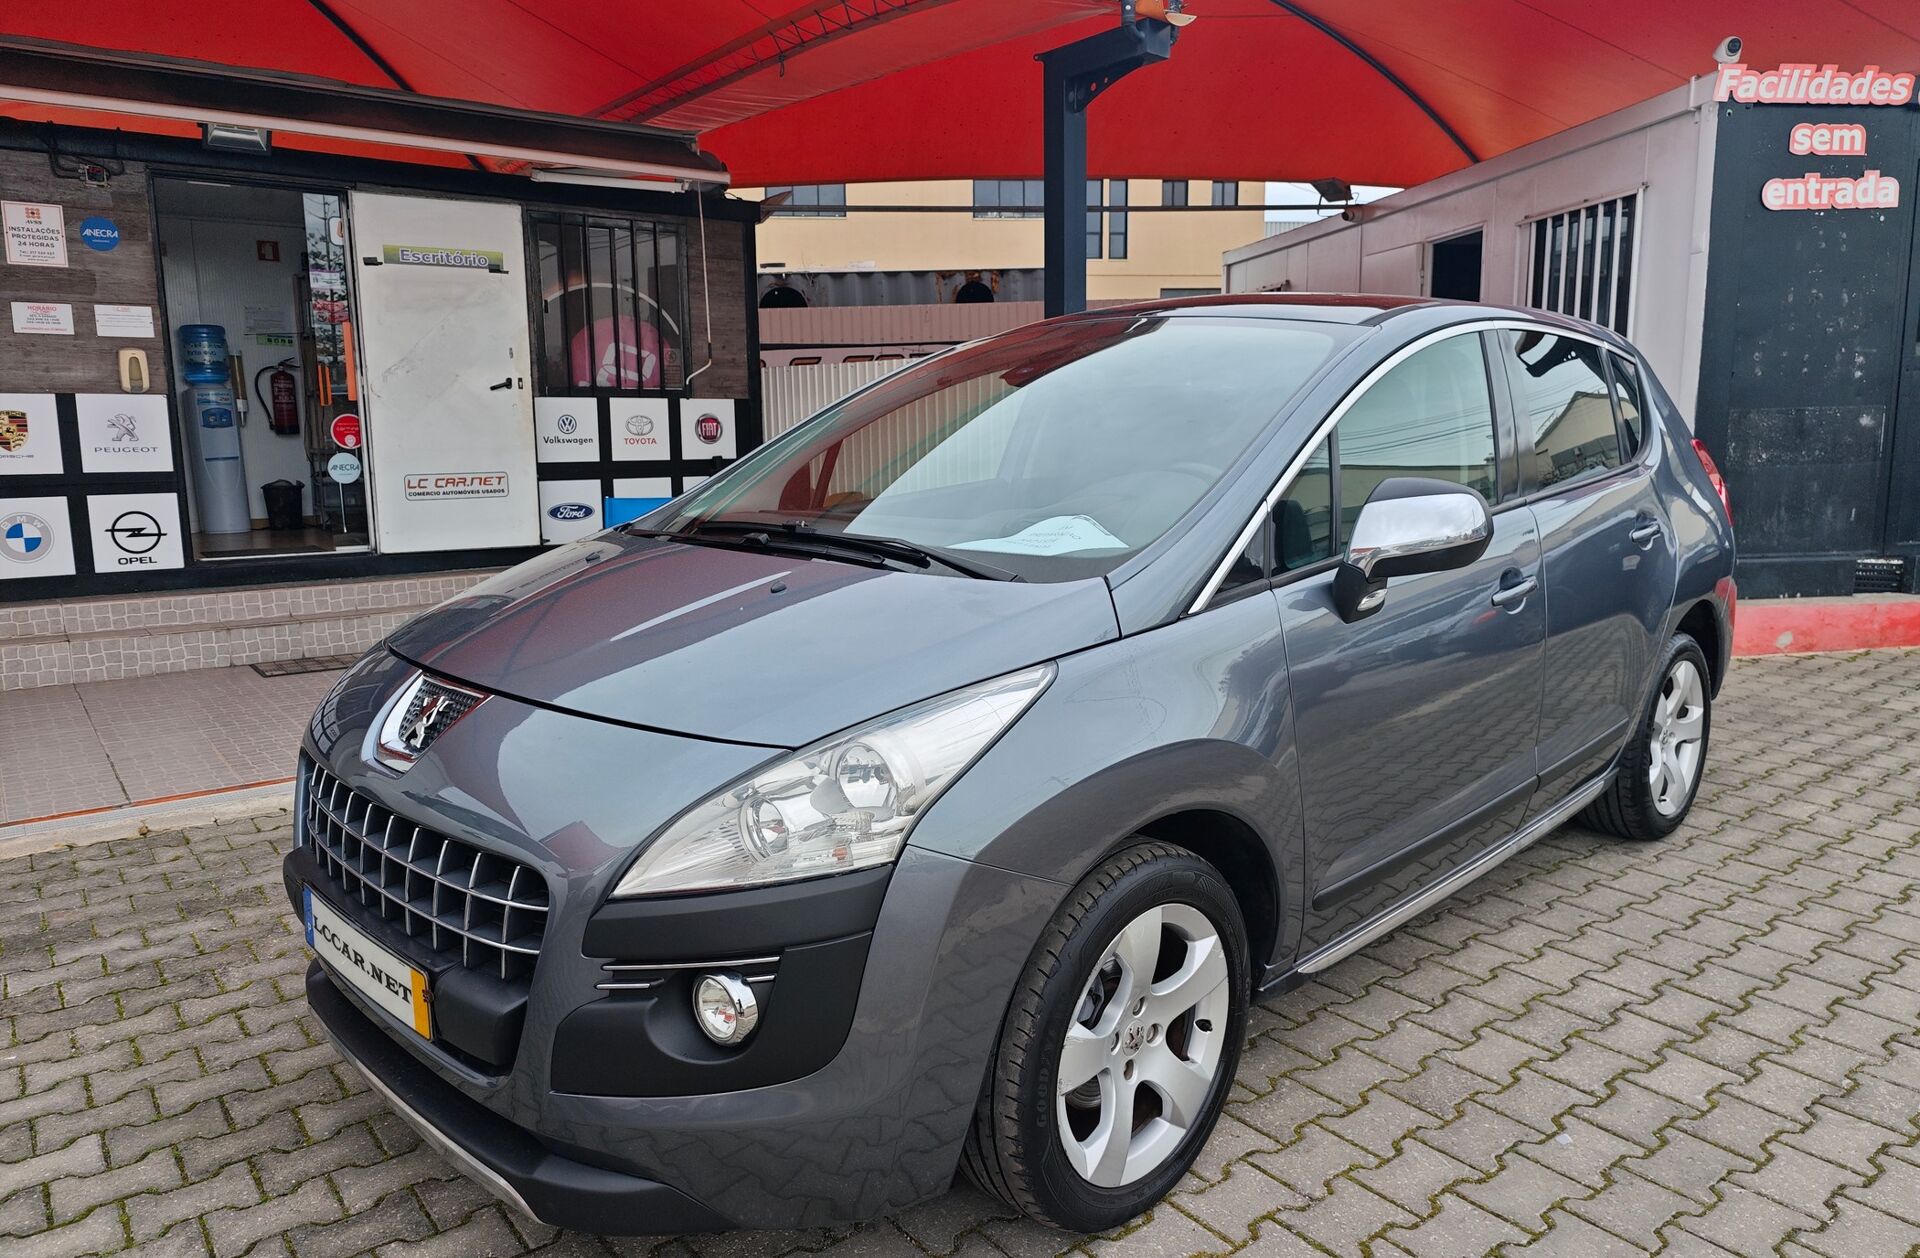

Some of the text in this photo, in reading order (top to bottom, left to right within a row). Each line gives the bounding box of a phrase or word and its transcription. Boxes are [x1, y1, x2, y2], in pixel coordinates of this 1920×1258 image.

[1716, 66, 1912, 102] Facilidades
[1791, 125, 1864, 153] sem
[1765, 173, 1898, 207] entrada
[11, 233, 60, 241] PROTEGIDAS
[82, 228, 119, 238] ANECRA
[400, 248, 488, 267] Escritório
[701, 422, 718, 437] FIAT
[543, 436, 594, 446] Volkswagen
[624, 437, 657, 445] TOYOTA
[407, 478, 428, 489] LC
[557, 505, 586, 519] Ford
[1, 515, 44, 529] BMW
[118, 556, 157, 565] OPEL
[313, 915, 412, 1004] LCCAR.NET
